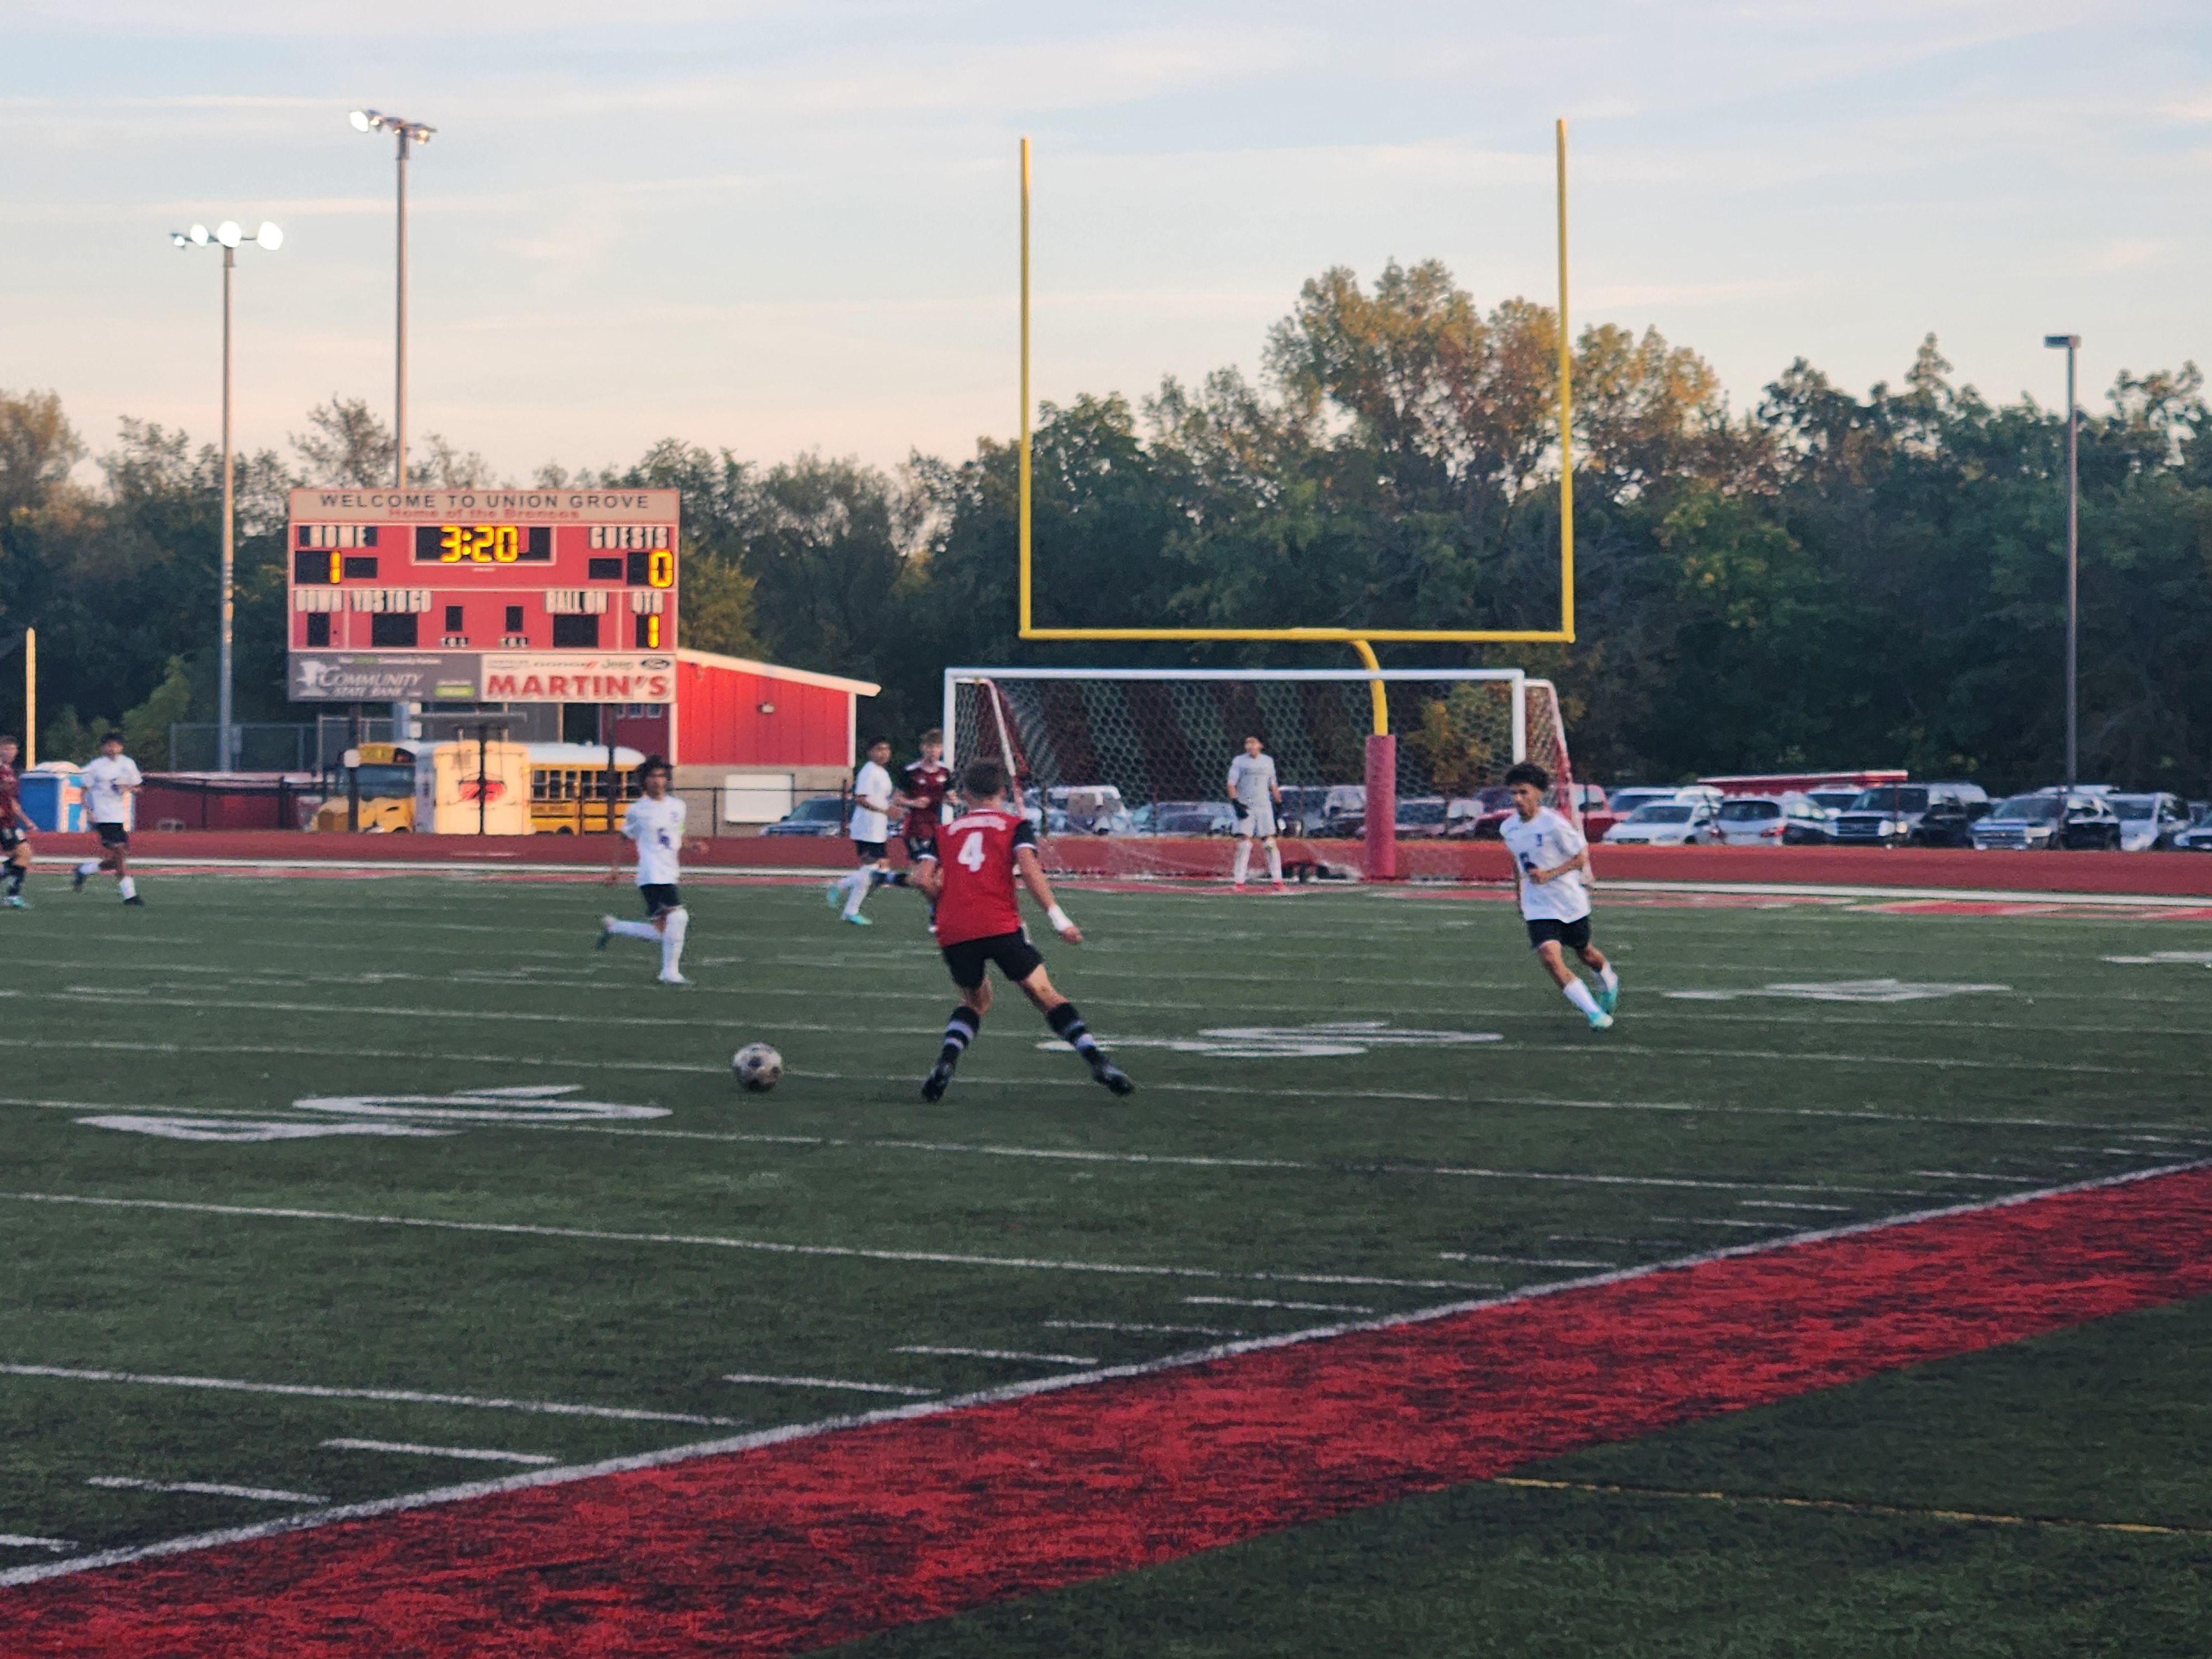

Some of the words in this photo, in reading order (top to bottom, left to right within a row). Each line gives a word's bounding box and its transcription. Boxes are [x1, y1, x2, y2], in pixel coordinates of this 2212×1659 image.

[320, 495, 436, 507] WELCOME
[448, 495, 475, 508] TO
[487, 495, 557, 508] UNION
[570, 495, 648, 508] GROVE
[440, 524, 518, 563] 3:20
[589, 526, 668, 550] GUESTS
[330, 551, 341, 584] 1
[649, 549, 674, 588] 0
[648, 614, 660, 648] 1
[487, 675, 667, 697] MARTIN'S
[957, 831, 986, 873] 4
